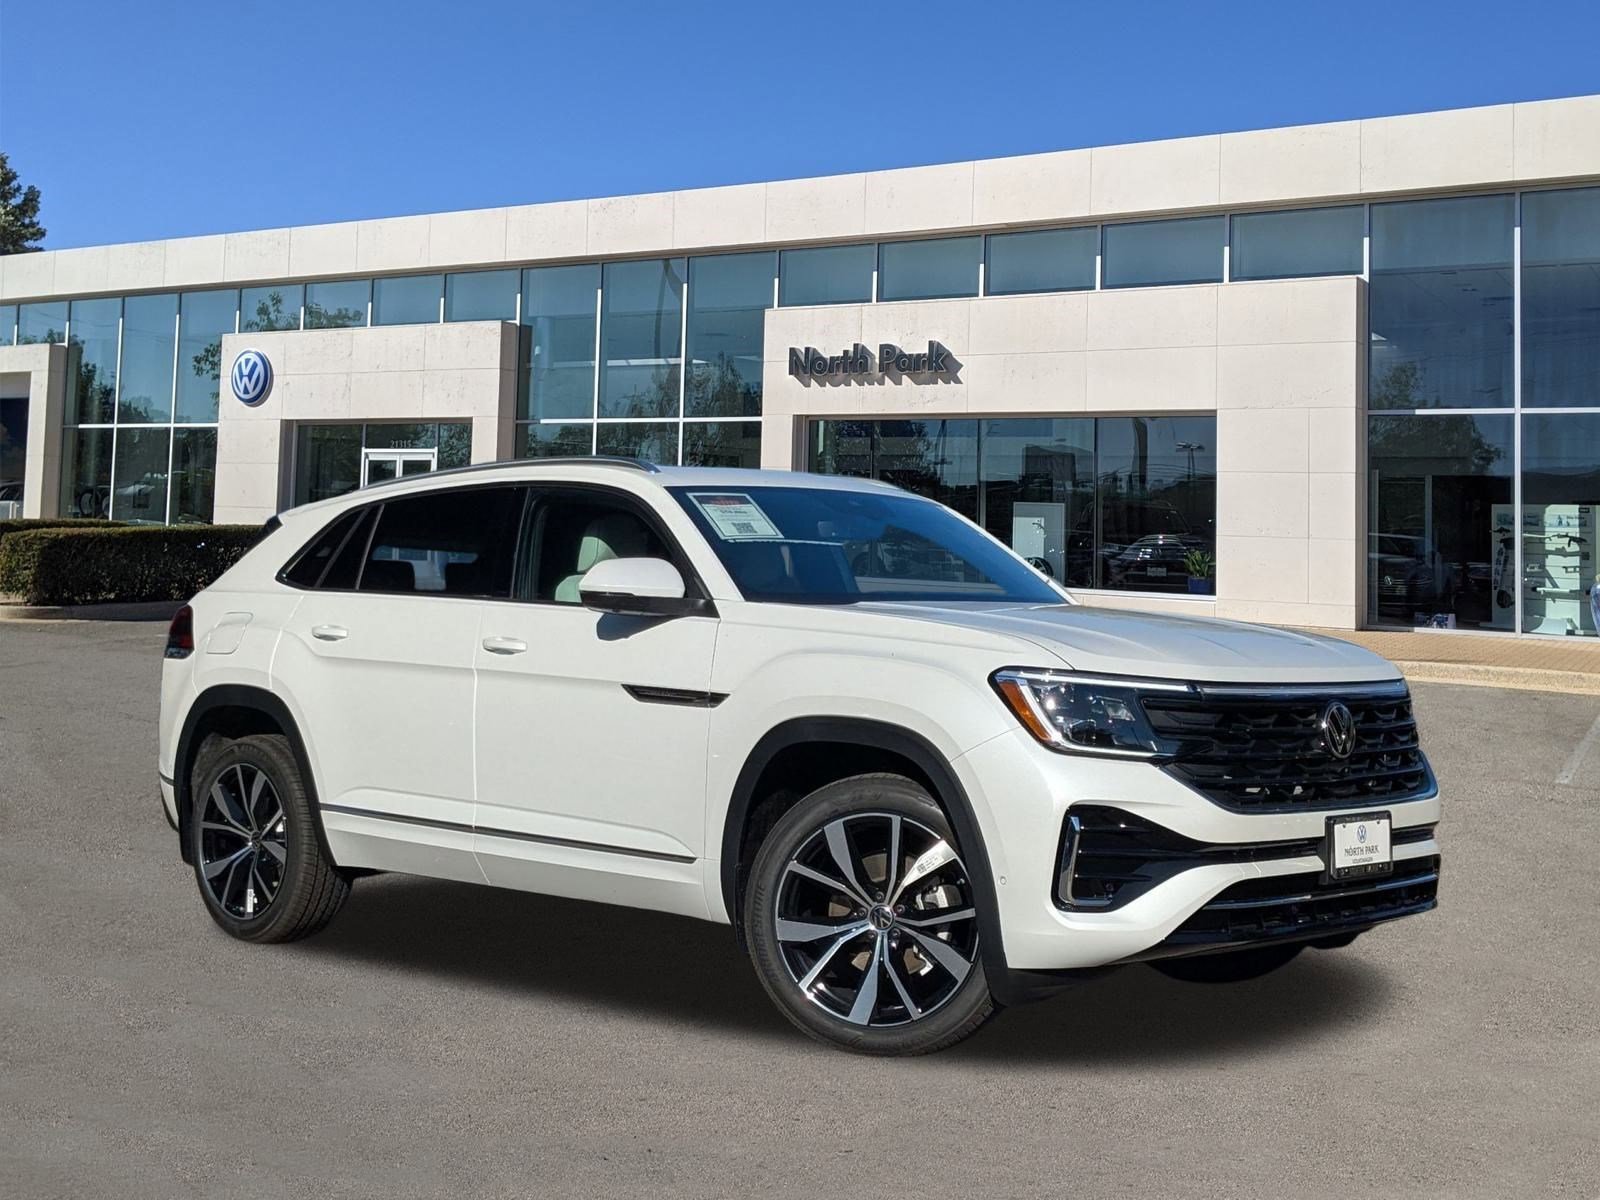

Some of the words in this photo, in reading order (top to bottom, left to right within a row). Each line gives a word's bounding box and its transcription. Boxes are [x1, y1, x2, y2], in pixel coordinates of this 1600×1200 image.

[788, 342, 871, 375] North
[878, 340, 947, 373] Park
[233, 352, 265, 399] VW
[1344, 846, 1365, 857] NORTH
[1365, 844, 1380, 855] PARK
